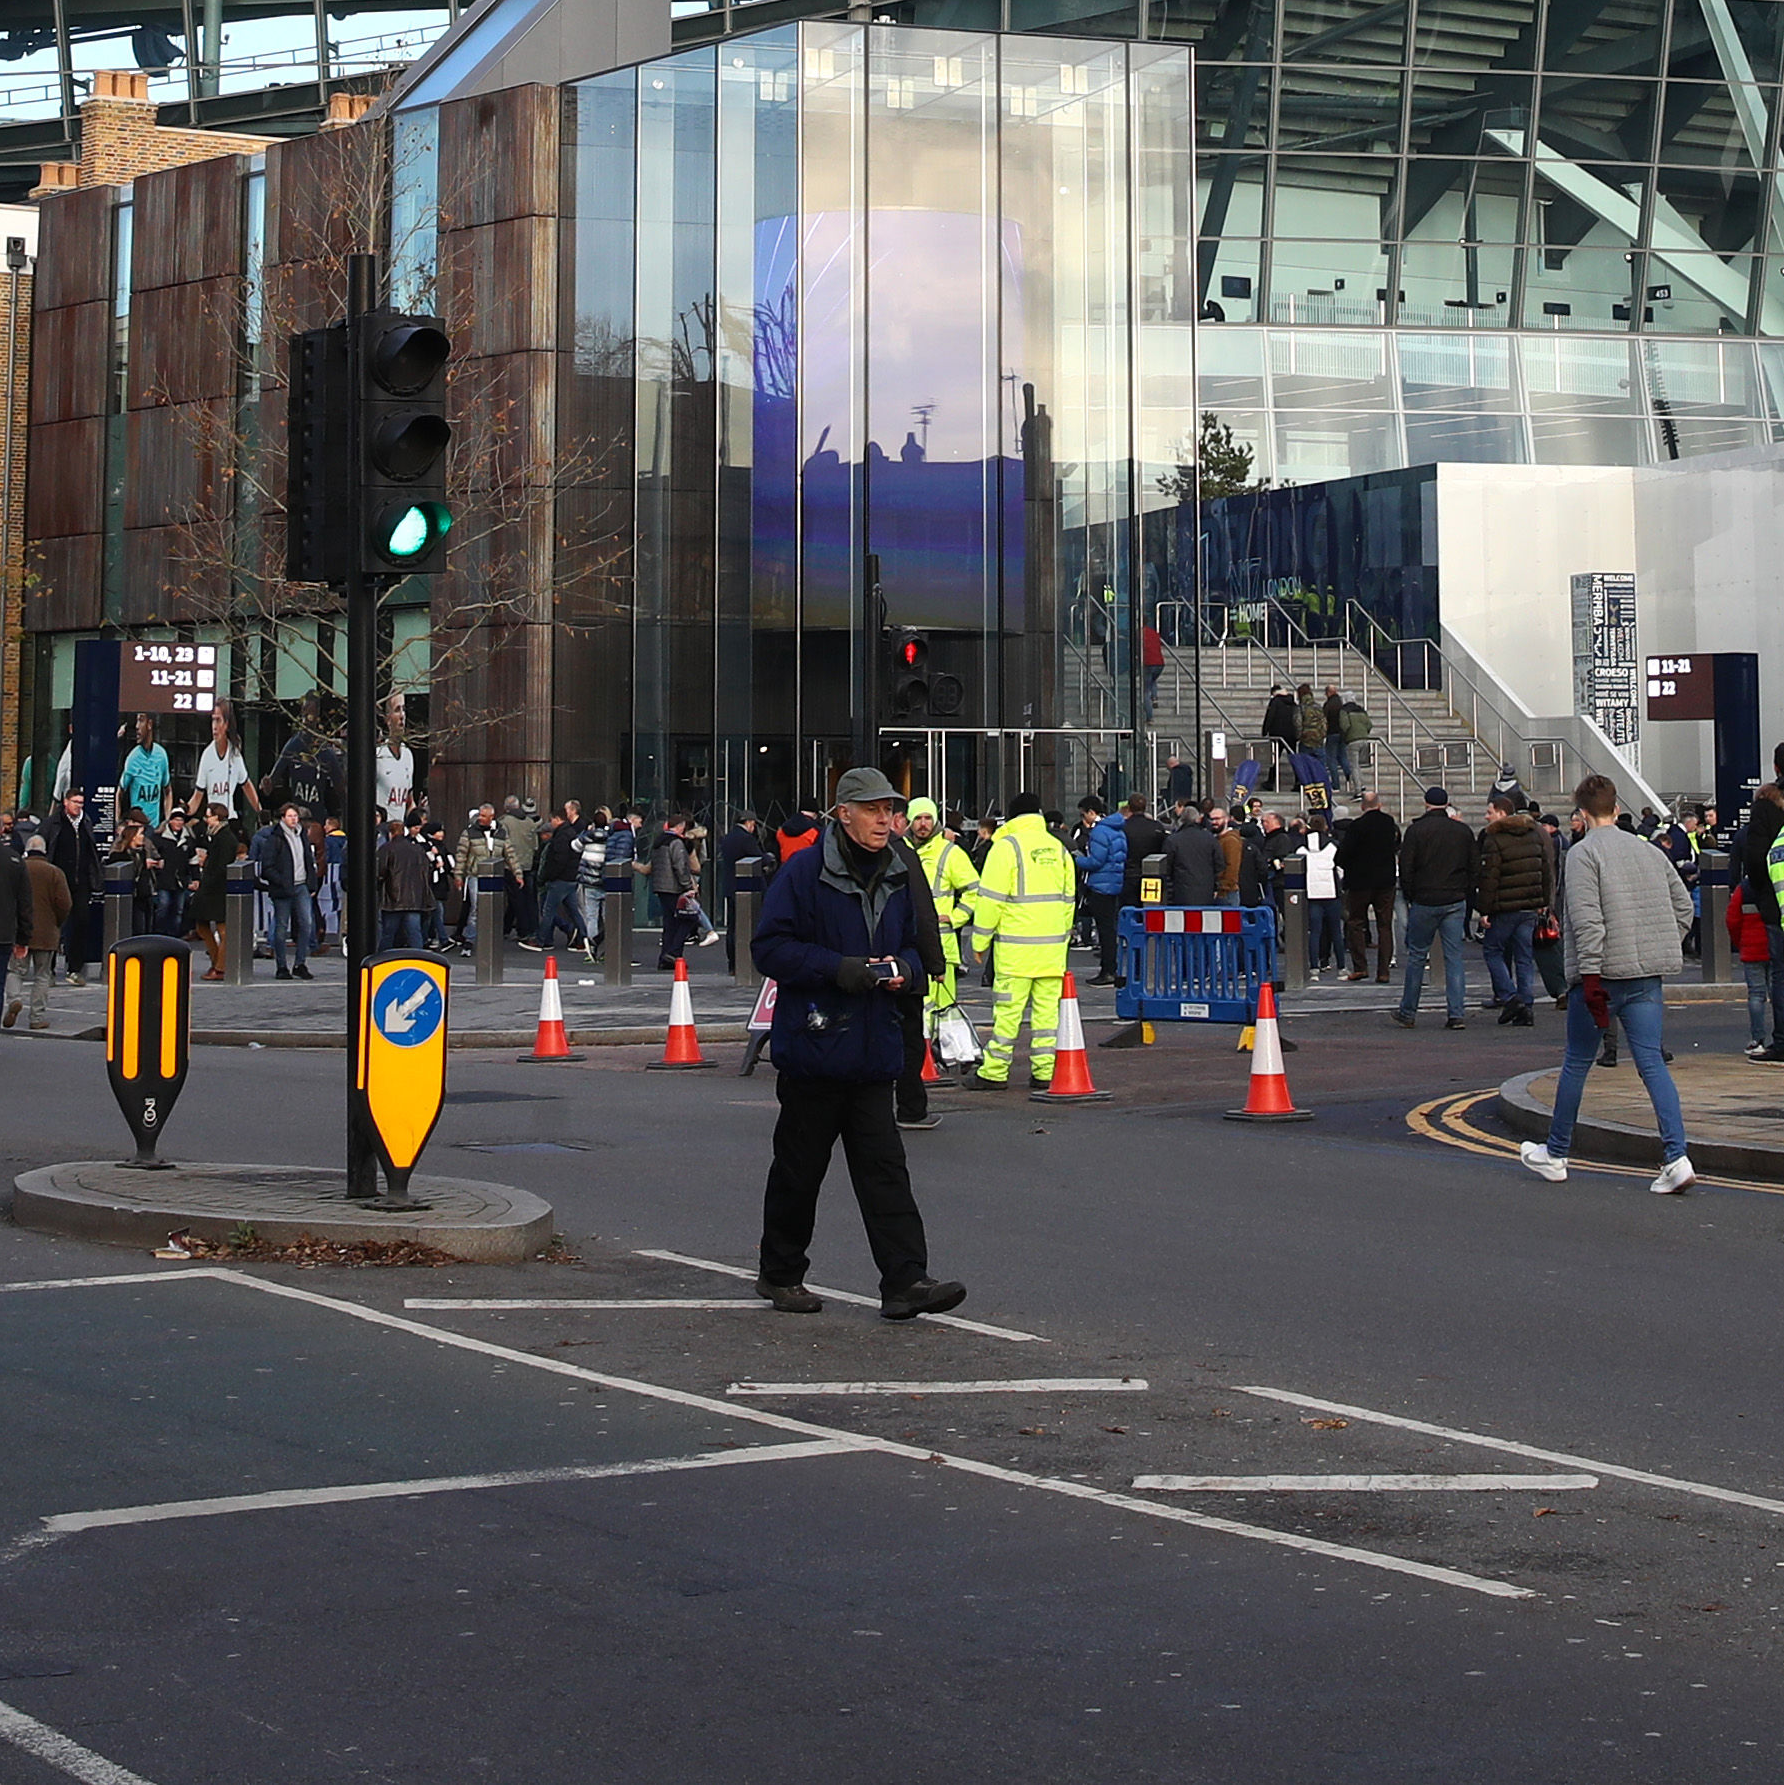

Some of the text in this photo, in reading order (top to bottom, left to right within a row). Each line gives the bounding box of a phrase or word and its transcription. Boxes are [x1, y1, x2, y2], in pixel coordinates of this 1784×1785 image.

[1262, 576, 1301, 598] LONDON
[175, 646, 194, 658] 23
[1595, 668, 1628, 677] CROESO
[1661, 658, 1692, 674] 11-21
[151, 669, 193, 686] 11-21
[1661, 680, 1676, 696] 22
[173, 693, 192, 709] 22
[137, 785, 160, 803] AIA
[212, 781, 229, 795] AIA
[294, 781, 319, 803] AIA
[388, 787, 410, 806] AIA
